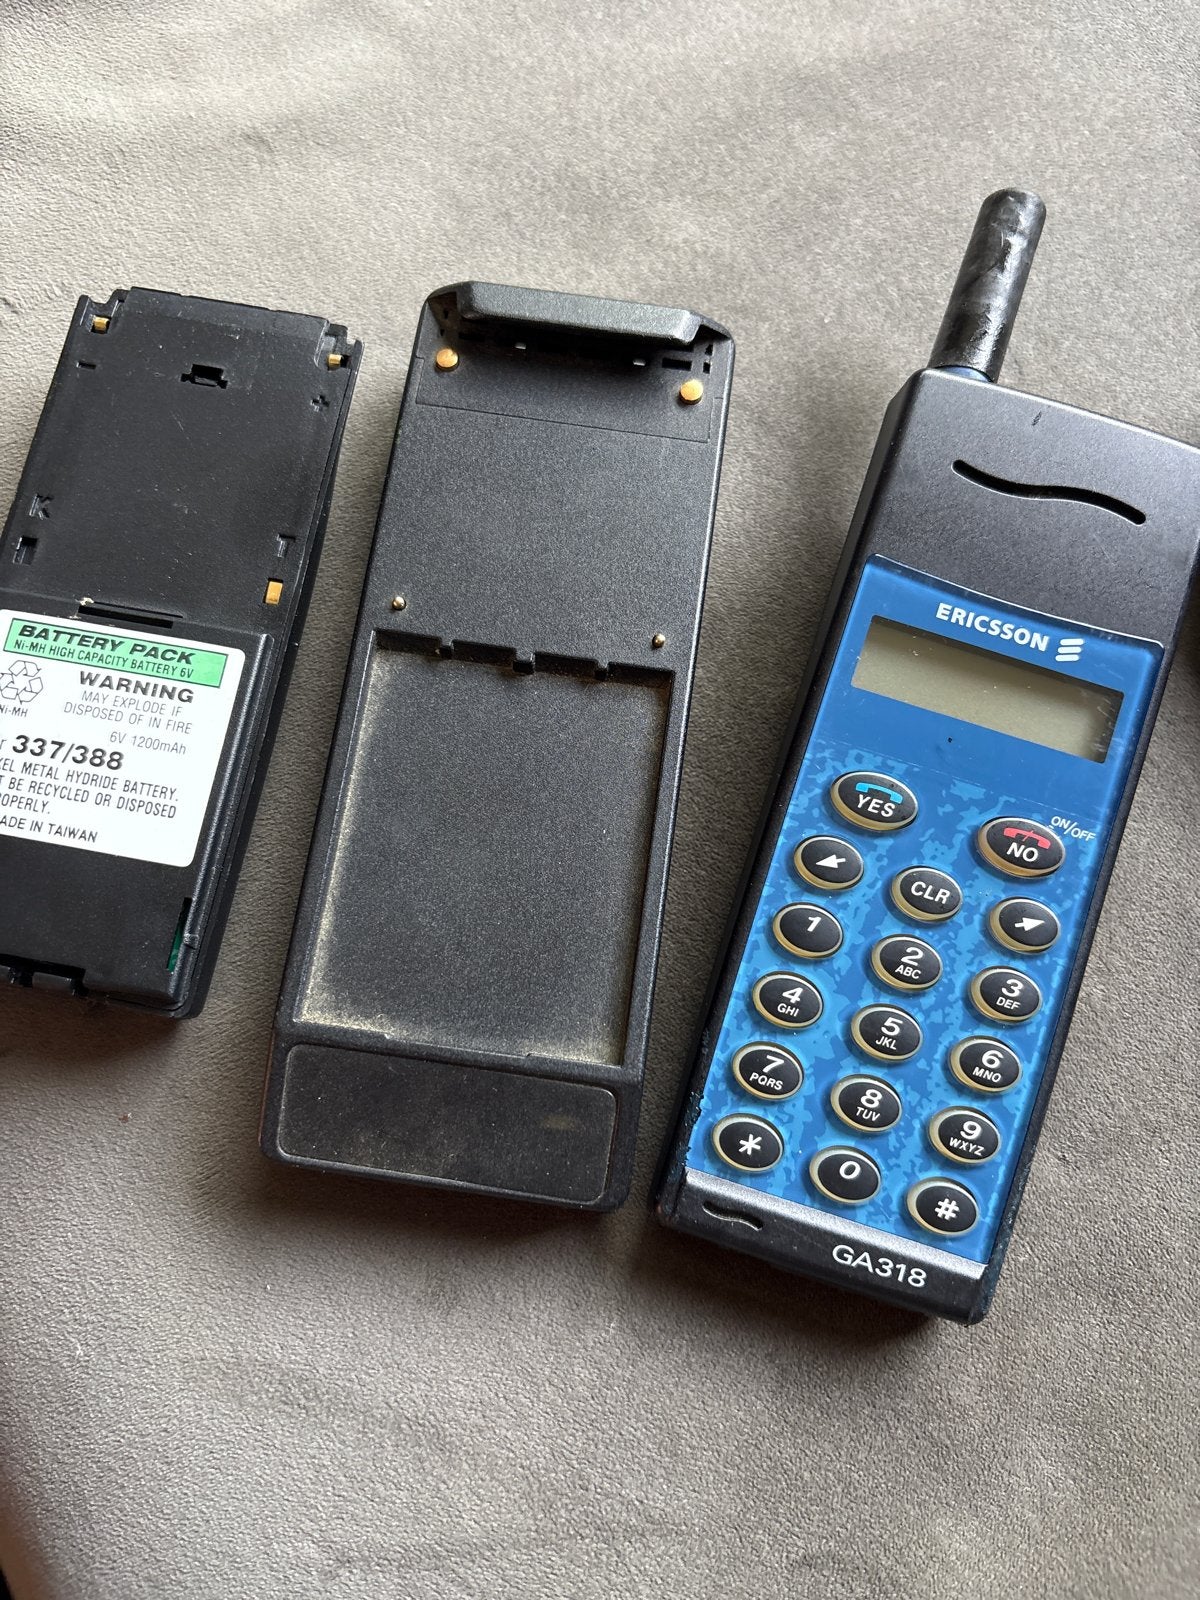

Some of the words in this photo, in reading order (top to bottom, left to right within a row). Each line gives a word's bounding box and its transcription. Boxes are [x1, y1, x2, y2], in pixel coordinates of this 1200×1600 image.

[29, 493, 54, 520] K
[936, 602, 1049, 652] ERICSSON
[18, 625, 125, 652] BATTERY
[129, 643, 196, 665] PACK
[14, 639, 46, 653] Ni-MH
[49, 646, 75, 659] HIGH
[78, 650, 129, 667] CAPACITY
[130, 659, 178, 676] BATTERY
[180, 667, 194, 679] 6V
[80, 671, 194, 704] WARNING
[81, 690, 109, 704] MAY
[113, 695, 166, 715] EXPLODE
[171, 706, 183, 717] IF
[63, 701, 124, 722] DISPOSED
[129, 713, 144, 725] OF
[148, 717, 161, 728] IN
[166, 719, 193, 735] FIRE
[12, 735, 124, 770] 337/388
[110, 731, 126, 744] 6V
[132, 735, 187, 755] 1200mAh
[21, 762, 59, 780] METAL
[66, 769, 119, 790] HYDRIDE
[123, 780, 178, 801] BATTERY.
[0, 792, 50, 814] OPERLY.
[8, 777, 25, 791] BE
[28, 781, 89, 803] RECYCLED
[94, 792, 112, 807] OR
[116, 796, 177, 818] DISPOSED
[857, 794, 896, 818] YES
[29, 820, 43, 832] IN
[48, 823, 98, 843] TAIWAN
[1050, 816, 1096, 842] ON/OFF
[1006, 842, 1039, 863] NO
[911, 881, 951, 904] CLR
[806, 917, 822, 933] 1
[901, 947, 924, 967] 2
[895, 965, 922, 980] ABC
[782, 986, 804, 1003] 4
[1001, 978, 1023, 998] 3
[777, 1003, 799, 1018] GHI
[996, 996, 1021, 1011] DEF
[880, 1017, 903, 1037] 5
[875, 1035, 898, 1051] JKL
[762, 1055, 785, 1074] 7
[981, 1049, 1004, 1069] 6
[749, 1072, 784, 1091] PQRS
[972, 1067, 1002, 1083] MNO
[860, 1088, 883, 1109] 8
[856, 1106, 881, 1122] TUV
[959, 1120, 982, 1141] 9
[949, 1137, 985, 1157] WXYZ
[839, 1160, 861, 1181] 0
[934, 1198, 960, 1221] #
[832, 1244, 928, 1288] GA318
